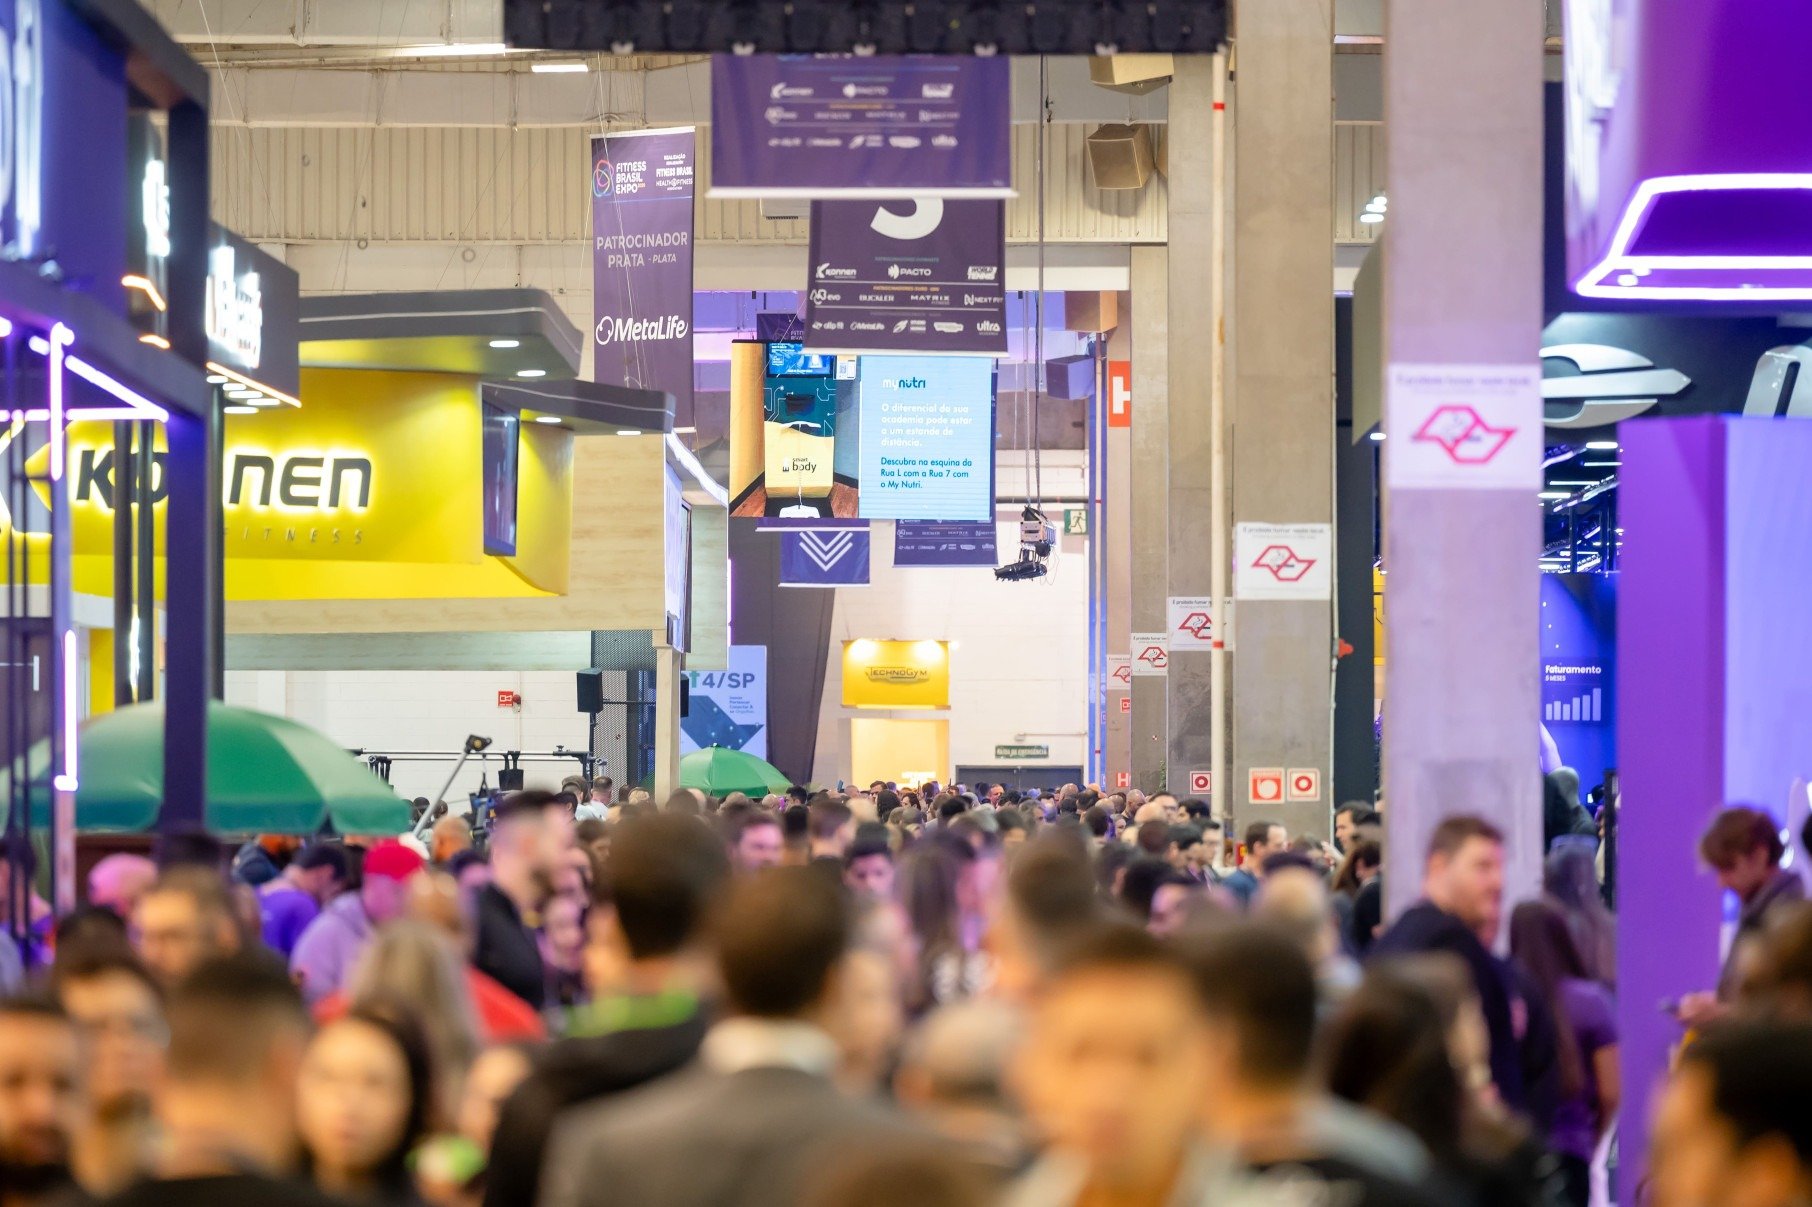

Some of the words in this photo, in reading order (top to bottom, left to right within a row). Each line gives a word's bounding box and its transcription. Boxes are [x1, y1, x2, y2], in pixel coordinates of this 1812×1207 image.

[616, 161, 647, 173] FITNESS
[615, 172, 643, 183] BRASIL
[615, 183, 638, 194] EXPO
[597, 232, 688, 250] PATROCINADOR
[608, 253, 645, 268] PRATA
[652, 253, 677, 263] PLATA
[900, 268, 932, 276] PACTO
[614, 315, 689, 342] MetaLife
[891, 403, 937, 413] diferencial
[881, 415, 924, 424] academia
[926, 416, 948, 426] pode
[950, 416, 973, 425] estar
[906, 427, 940, 436] estande
[792, 461, 817, 473] body
[880, 457, 917, 466] Descubra
[930, 458, 960, 468] esquina
[880, 469, 895, 477] Rua
[897, 469, 902, 477] L
[928, 469, 943, 478] Rua
[945, 469, 951, 478] 7
[887, 481, 899, 489] My
[901, 481, 923, 489] Nutri.
[1545, 665, 1602, 674] Faturamento
